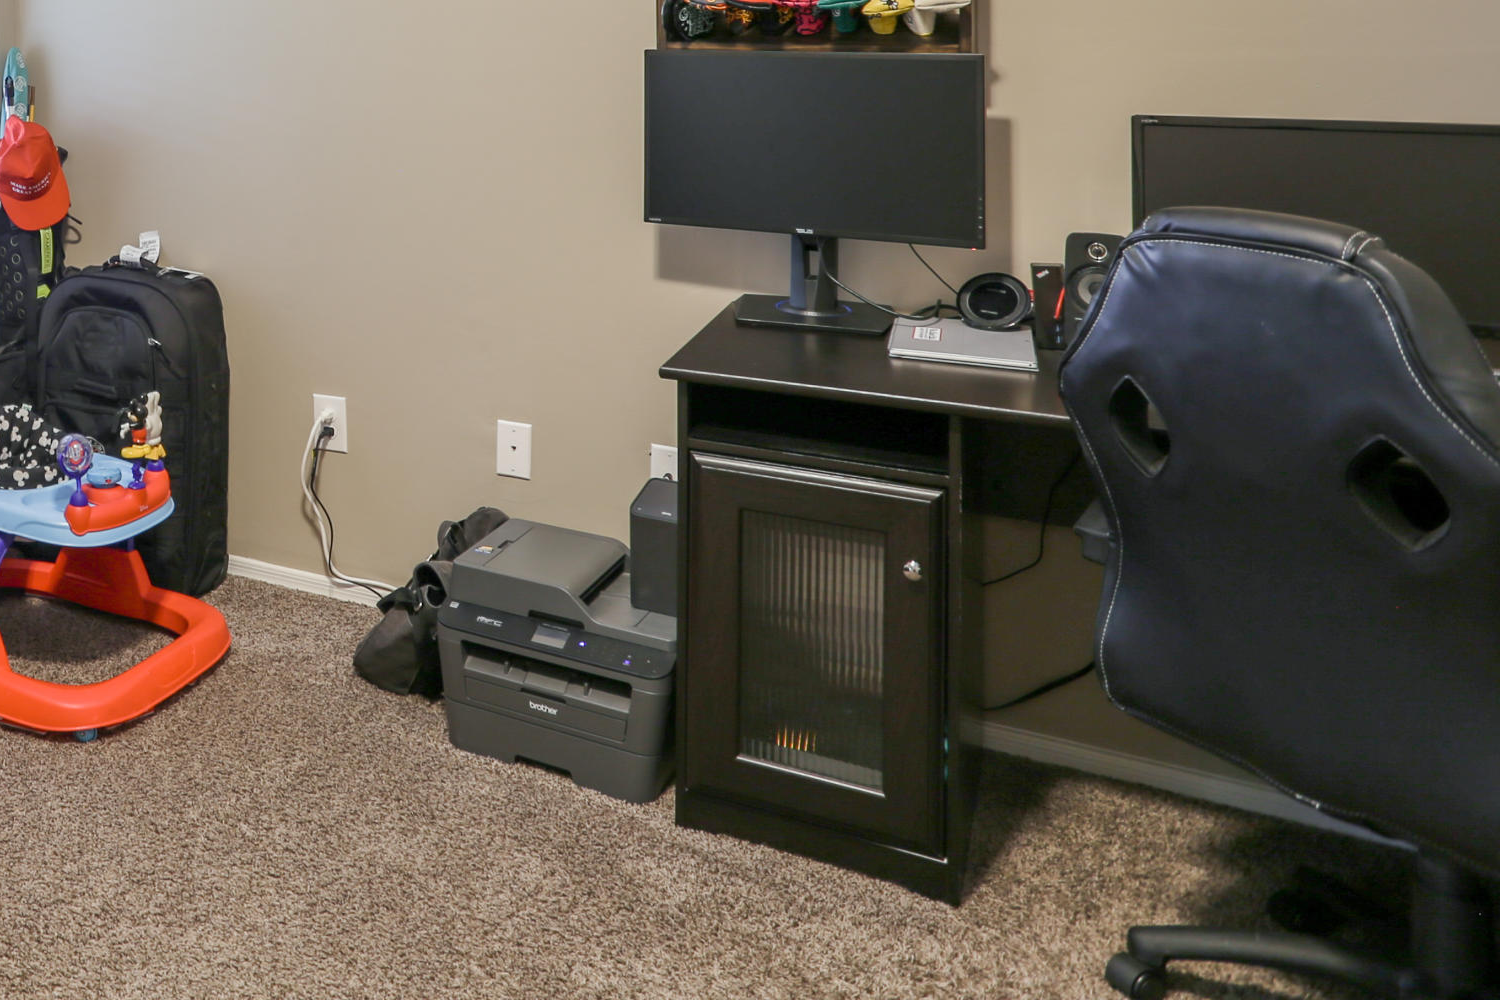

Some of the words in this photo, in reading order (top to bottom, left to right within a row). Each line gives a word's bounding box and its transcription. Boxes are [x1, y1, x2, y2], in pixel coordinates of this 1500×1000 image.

[10, 180, 27, 191] MAKE
[12, 186, 32, 195] GREAT
[529, 700, 558, 716] brother
